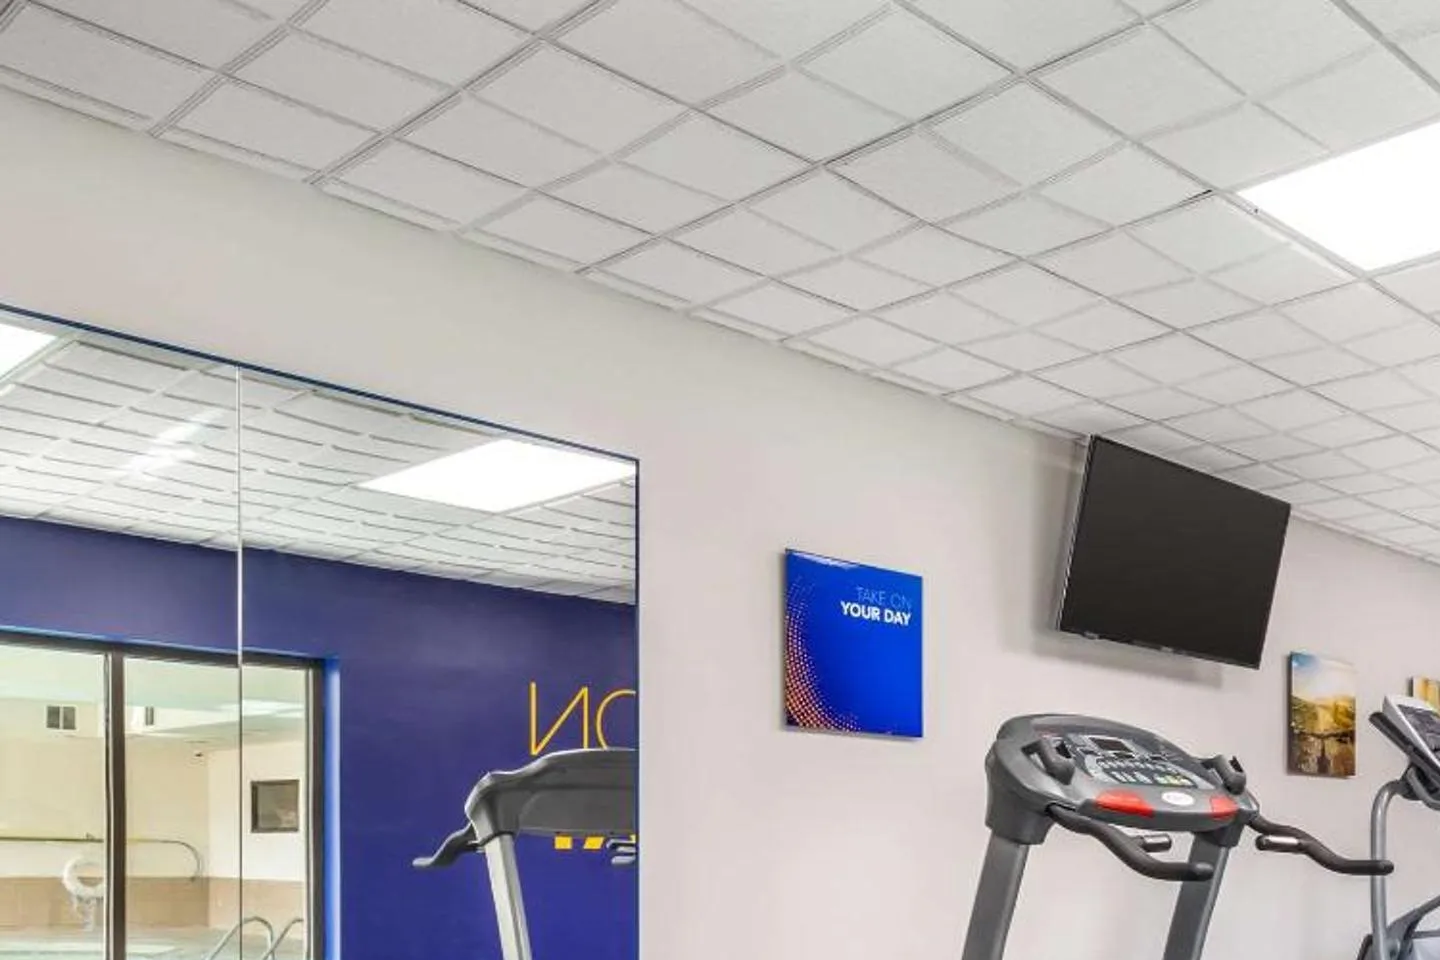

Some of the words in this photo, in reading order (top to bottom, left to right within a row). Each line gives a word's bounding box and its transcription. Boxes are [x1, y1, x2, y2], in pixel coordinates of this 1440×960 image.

[855, 586, 886, 606] TAKE
[889, 592, 912, 612] ON
[840, 600, 880, 621] YOUR
[884, 608, 912, 626] DAY
